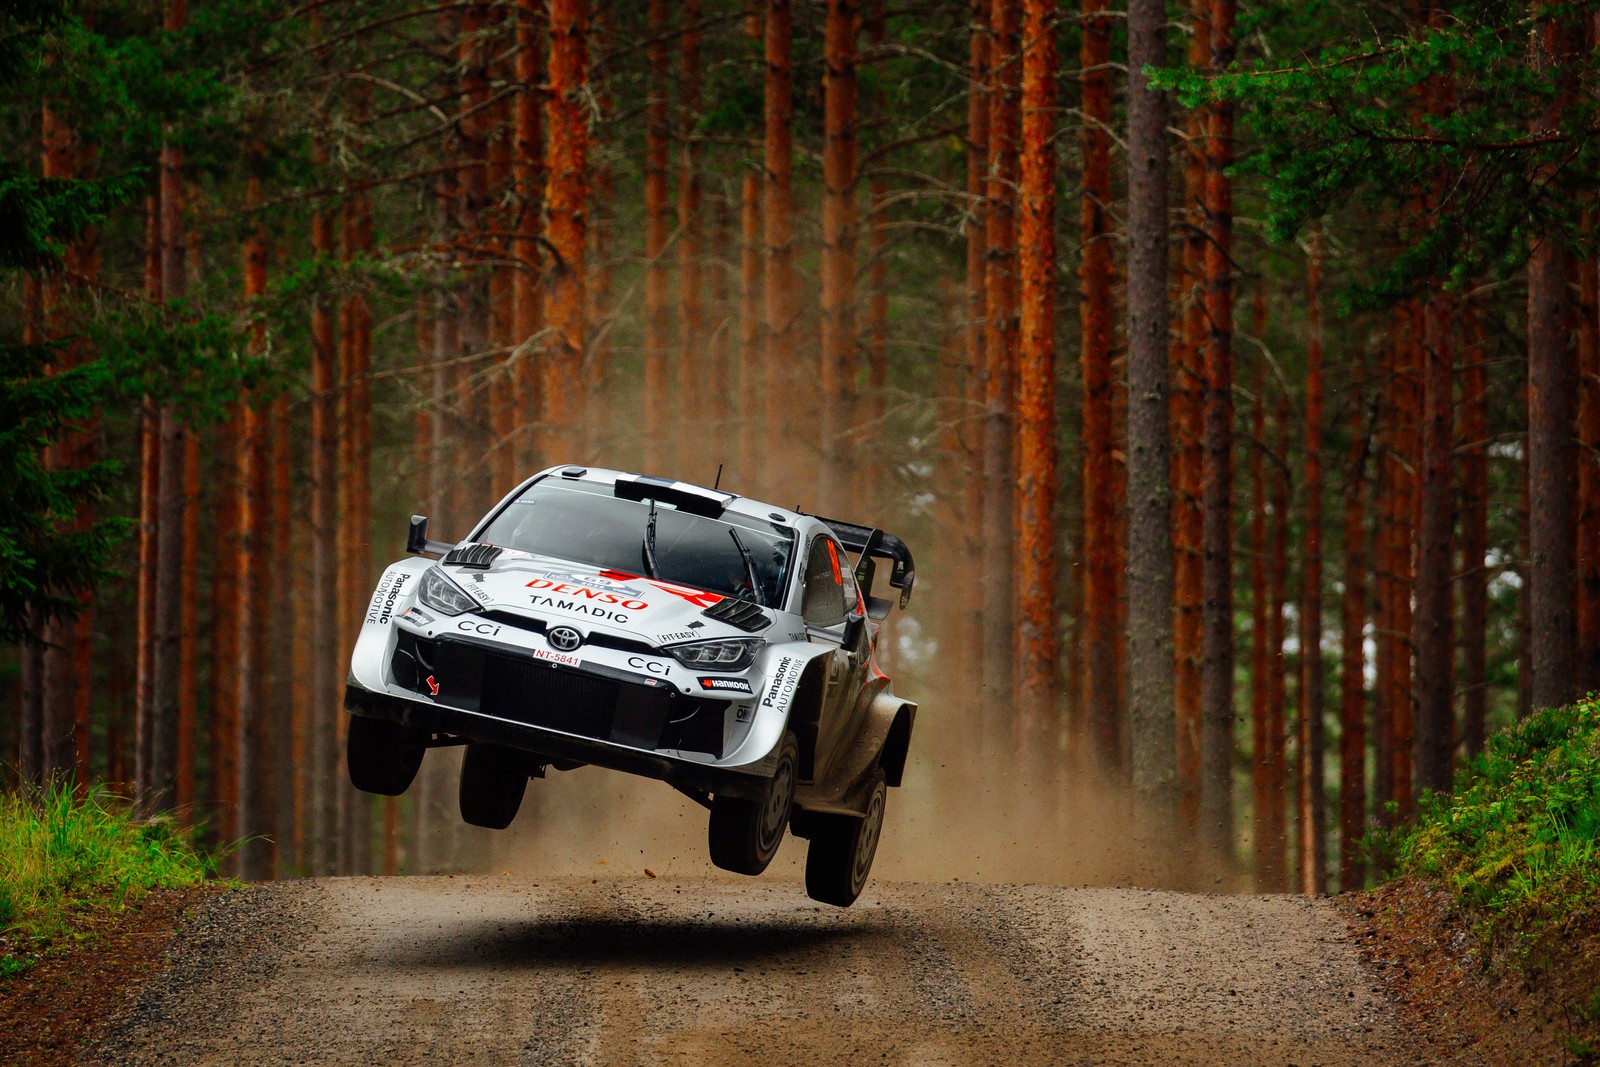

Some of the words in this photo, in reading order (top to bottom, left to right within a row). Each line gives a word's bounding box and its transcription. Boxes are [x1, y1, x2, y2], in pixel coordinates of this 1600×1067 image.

[367, 571, 397, 624] AUTOMOTIVE
[380, 573, 411, 625] Panasonic
[524, 578, 649, 611] DENSO
[529, 594, 629, 624] TAMADIC
[535, 649, 579, 666] NT-5841
[762, 656, 792, 708] Panasonic
[776, 659, 805, 714] AUTOMOTIVE
